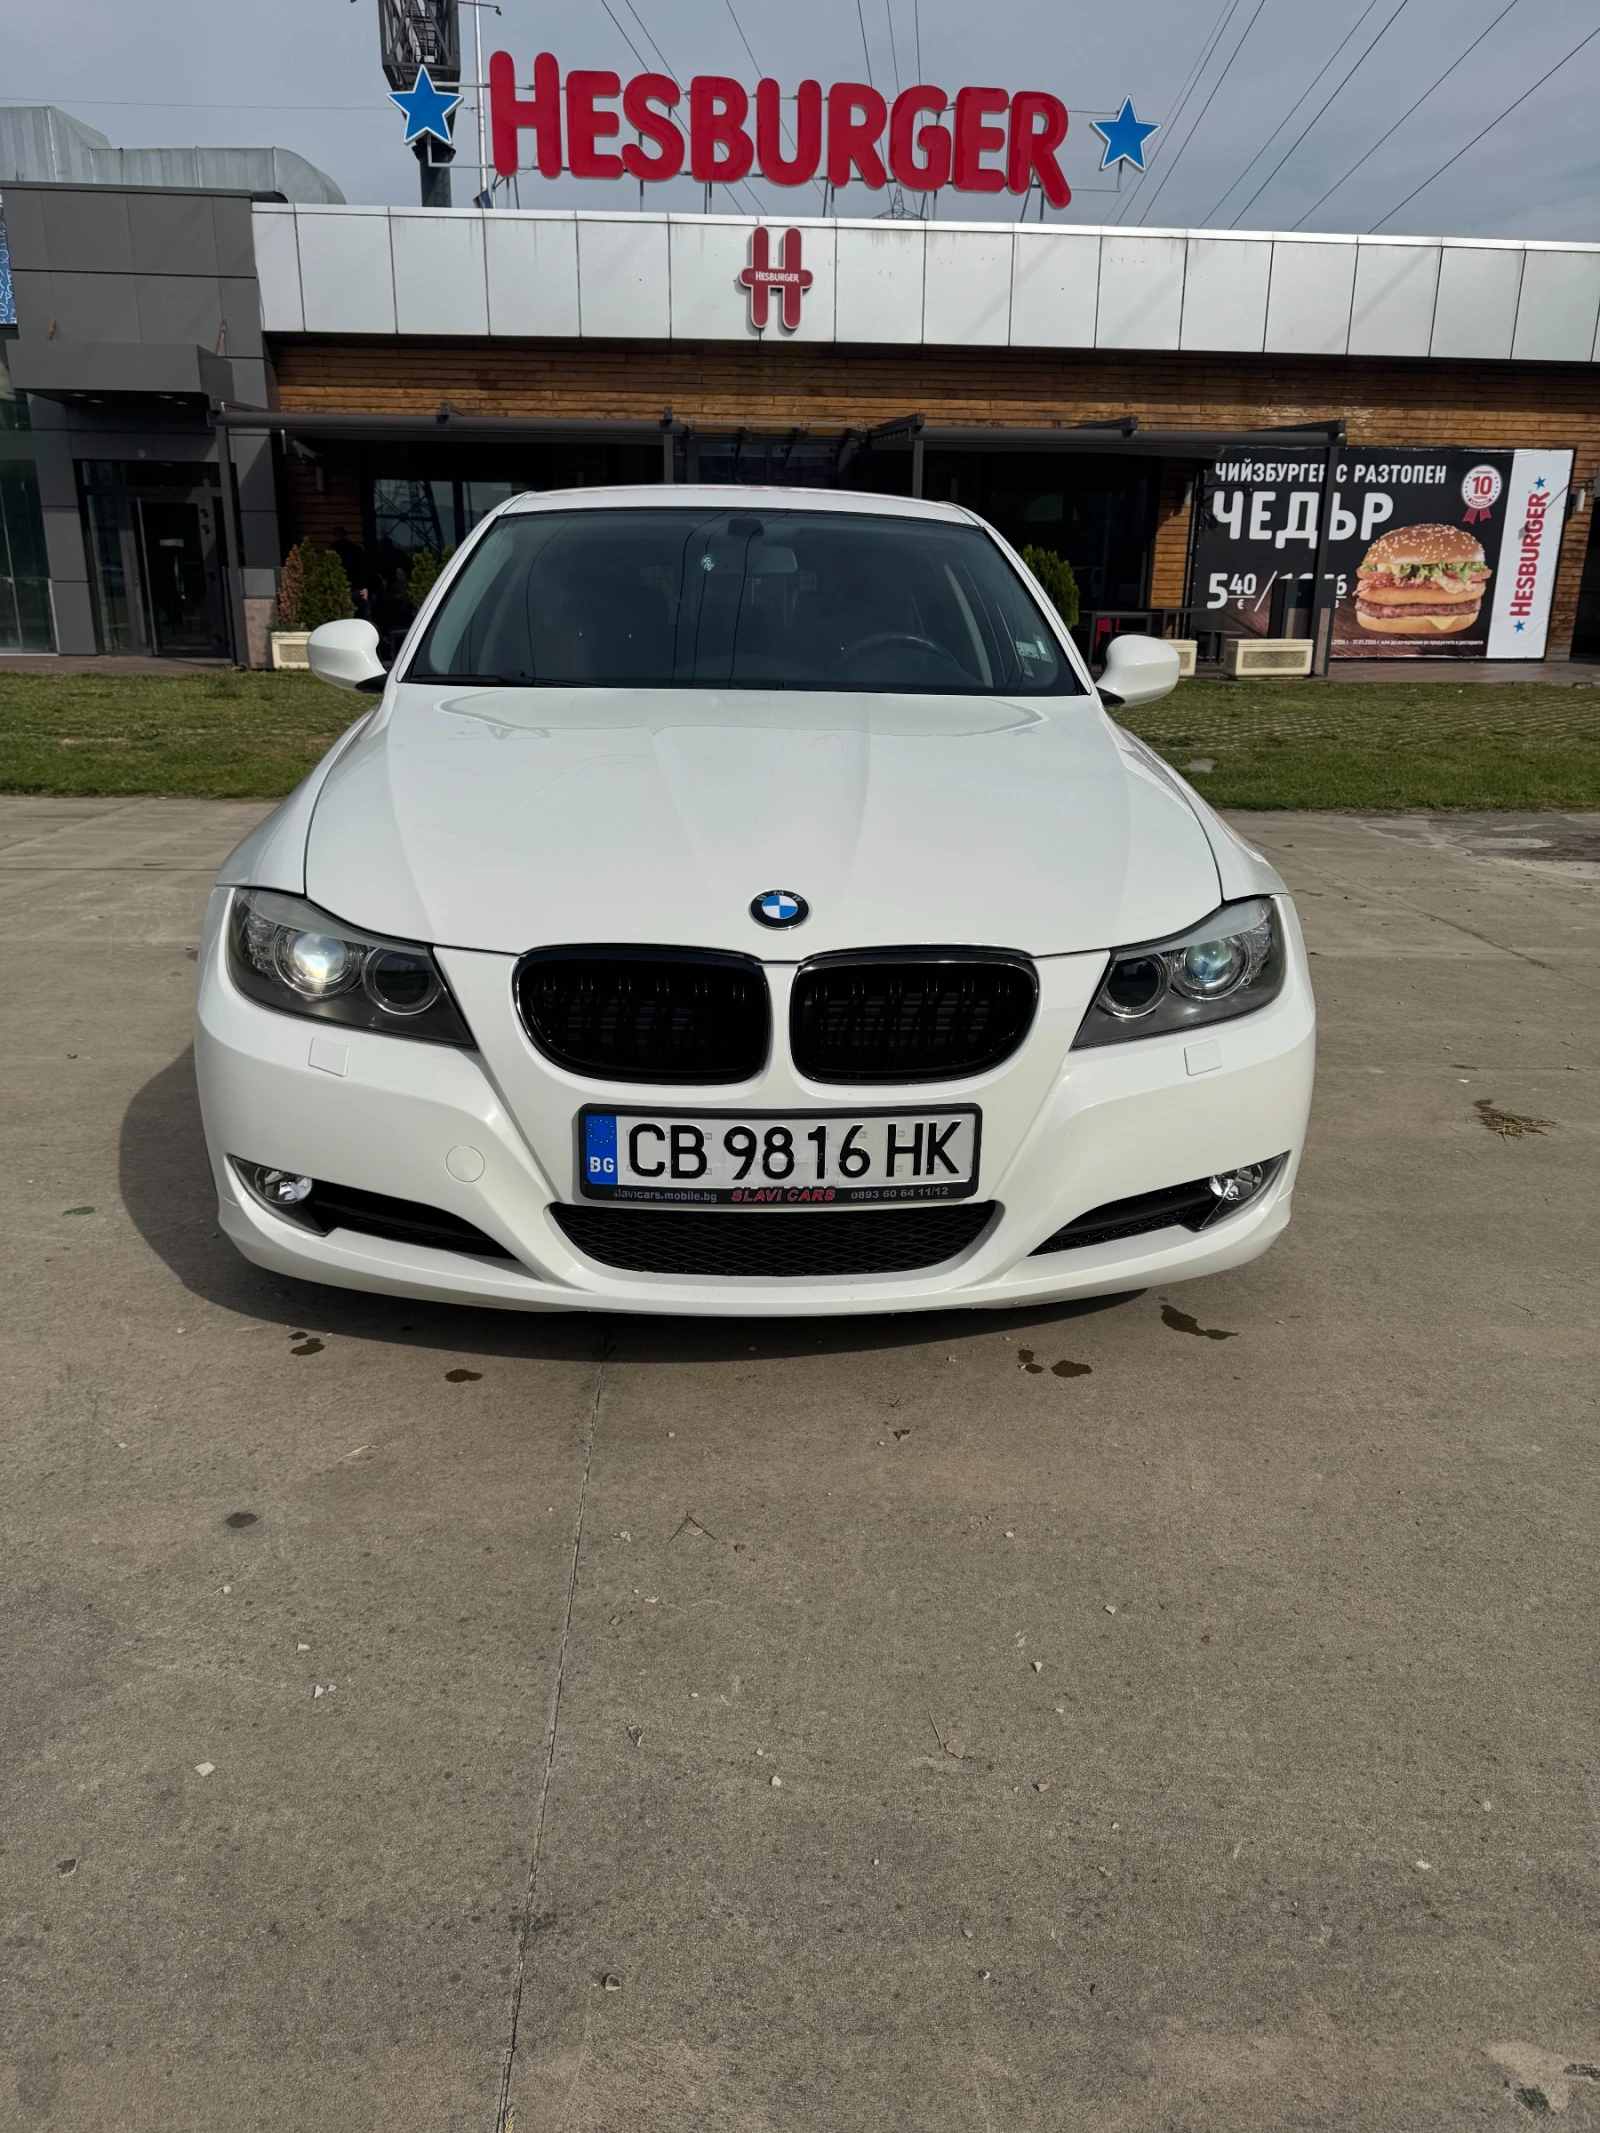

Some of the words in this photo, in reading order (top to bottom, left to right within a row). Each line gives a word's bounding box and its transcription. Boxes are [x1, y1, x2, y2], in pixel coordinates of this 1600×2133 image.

[489, 50, 1072, 209] HESBURGER
[755, 271, 800, 283] HESBURGER
[1354, 465, 1447, 484] РАЗТОПЕН
[1472, 476, 1493, 495] 10
[1509, 492, 1550, 616] HESBURGER
[629, 1123, 707, 1179] CB
[723, 1124, 871, 1180] 9816
[886, 1121, 962, 1177] HK
[590, 1156, 614, 1173] BG
[612, 1188, 717, 1203] slavicars.mobile.bg
[787, 1188, 836, 1202] CARS
[851, 1190, 879, 1200] 0893
[882, 1189, 897, 1199] 60
[900, 1188, 914, 1198] 64
[918, 1186, 949, 1197] 11/12
